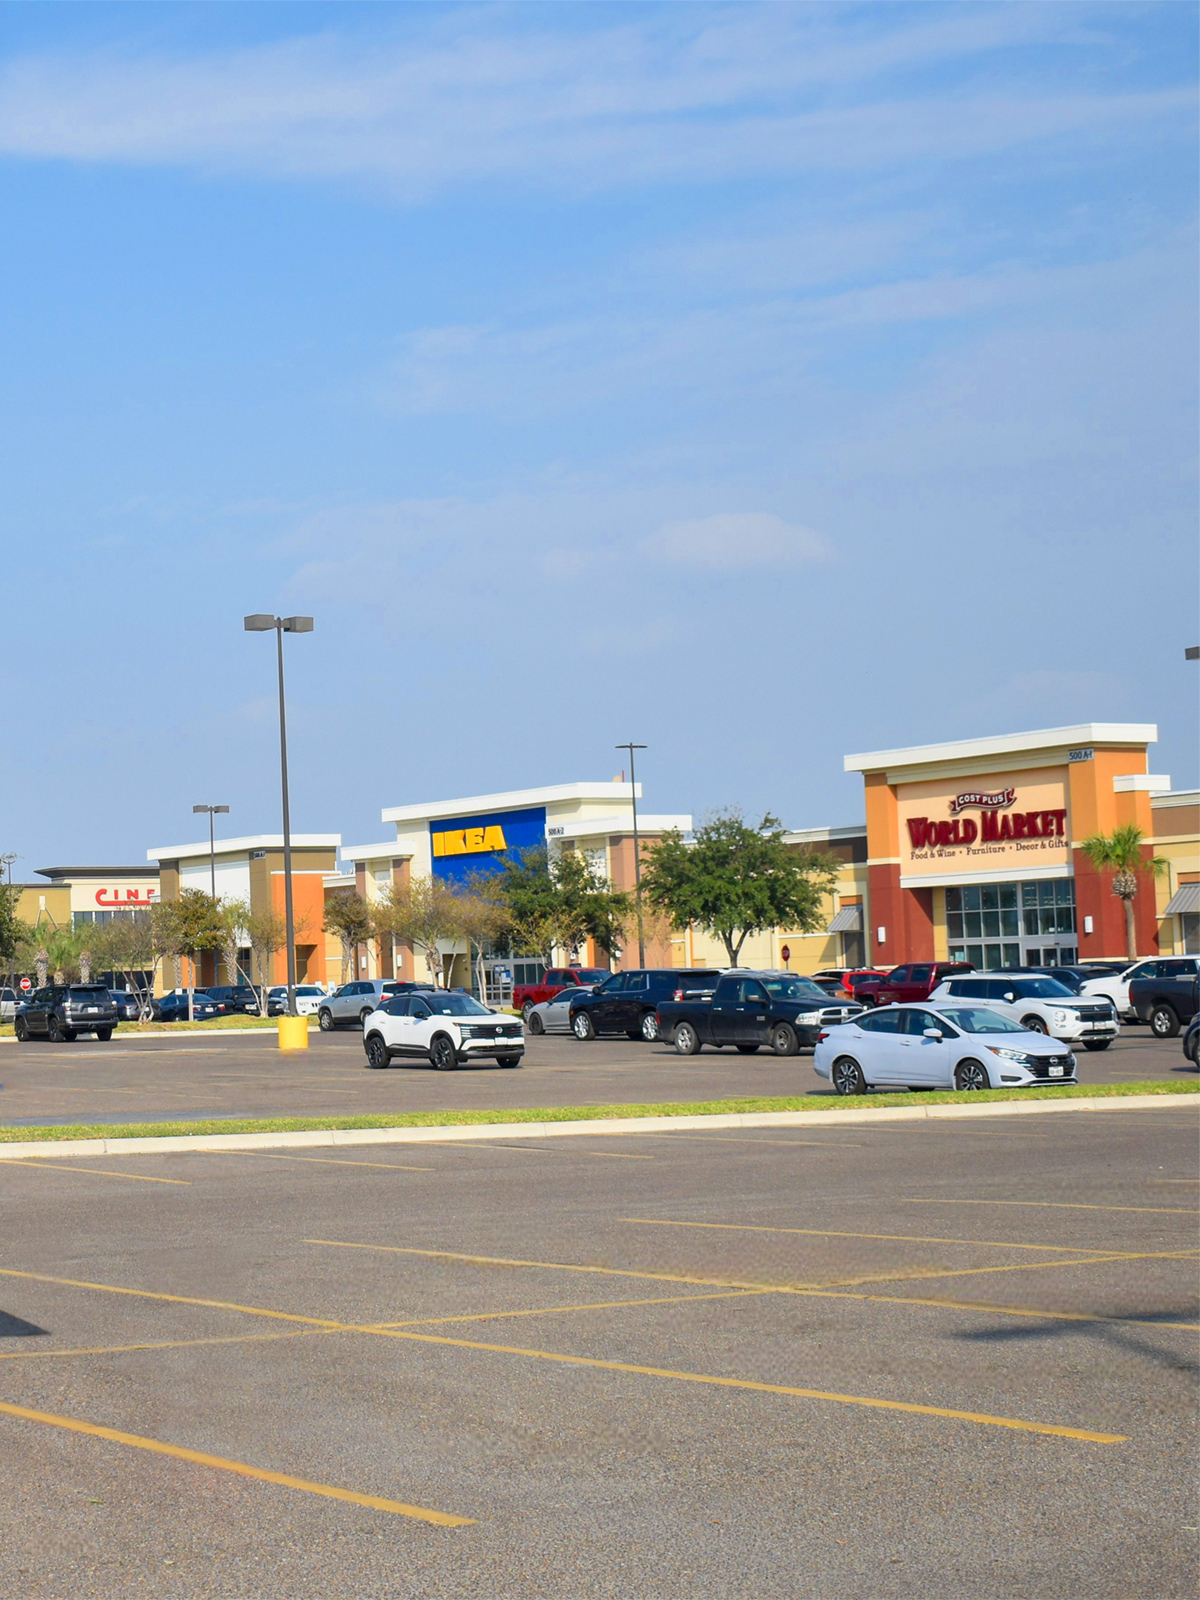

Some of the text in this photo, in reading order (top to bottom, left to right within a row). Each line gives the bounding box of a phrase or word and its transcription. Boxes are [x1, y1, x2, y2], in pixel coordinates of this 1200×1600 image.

[958, 794, 1004, 804] COST PLUS
[432, 825, 507, 856] IKEA
[906, 809, 1067, 848] WORLD MARKET
[910, 839, 1069, 860] Food & Wine Furniture Decor & Gifts
